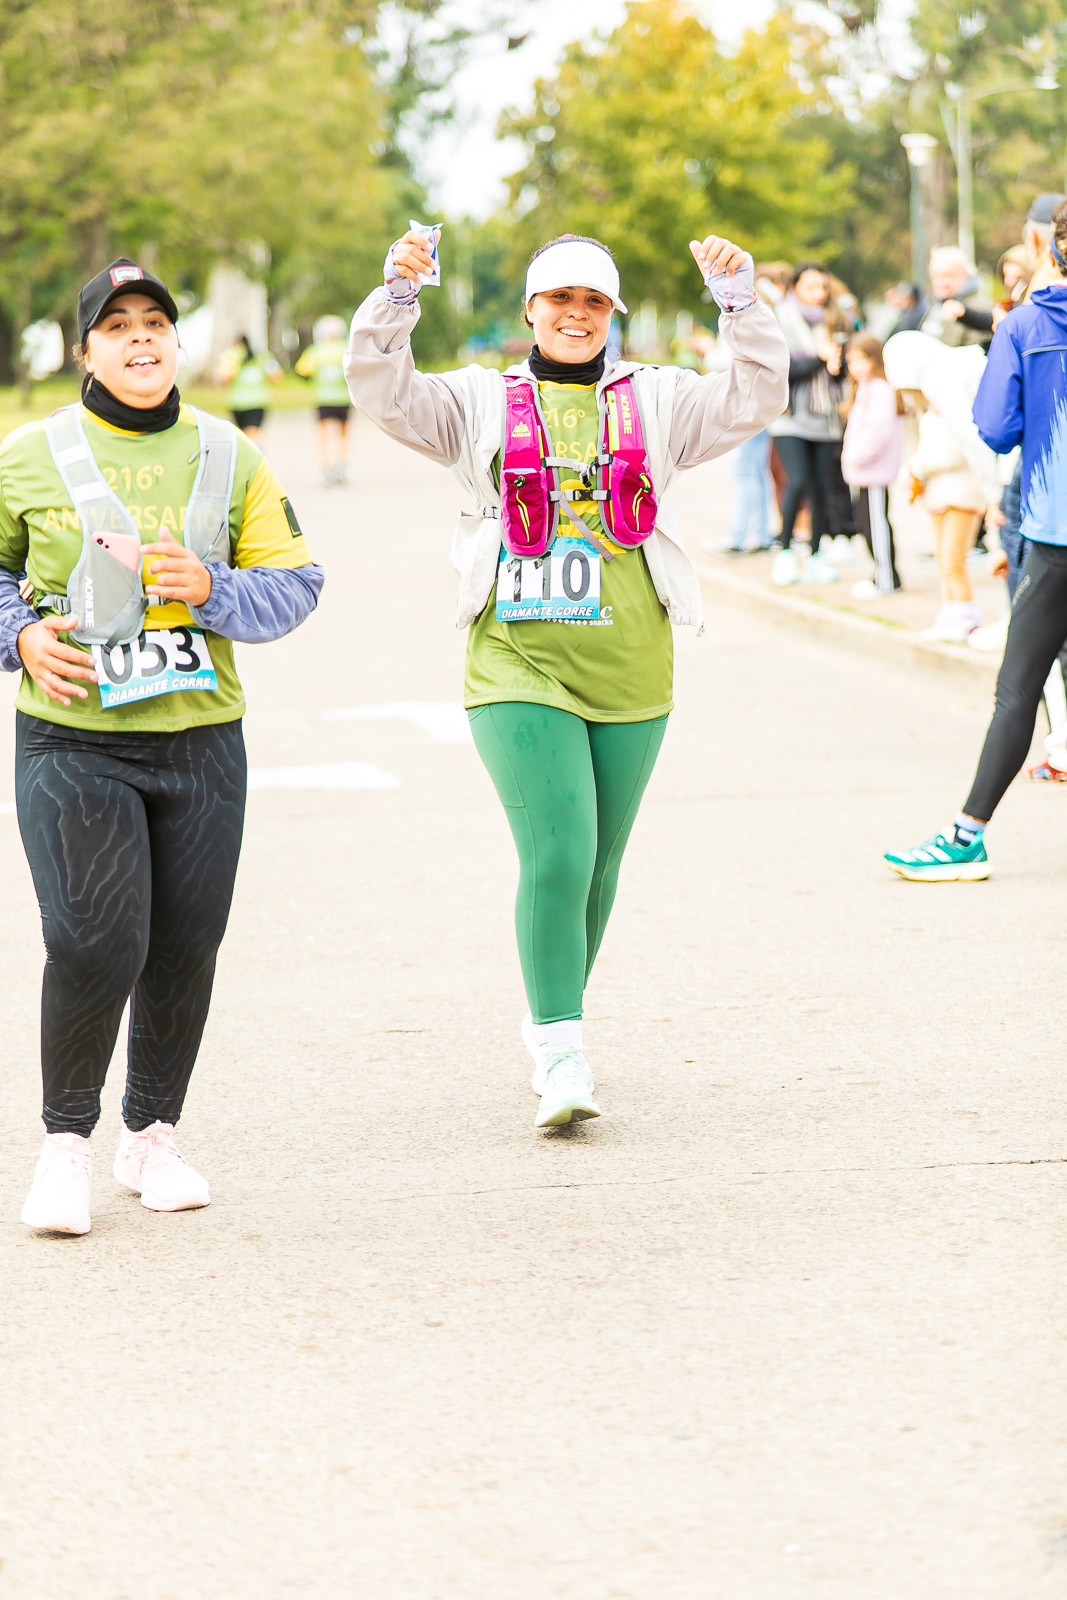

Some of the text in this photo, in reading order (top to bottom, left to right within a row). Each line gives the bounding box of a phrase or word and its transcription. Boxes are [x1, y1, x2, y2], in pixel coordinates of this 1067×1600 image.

[506, 549, 591, 603] 110
[500, 606, 595, 619] DIAMANTE CORRE
[588, 618, 614, 627] snacks
[100, 626, 201, 685] 053
[107, 677, 212, 705] DIAMANTE CORRE
